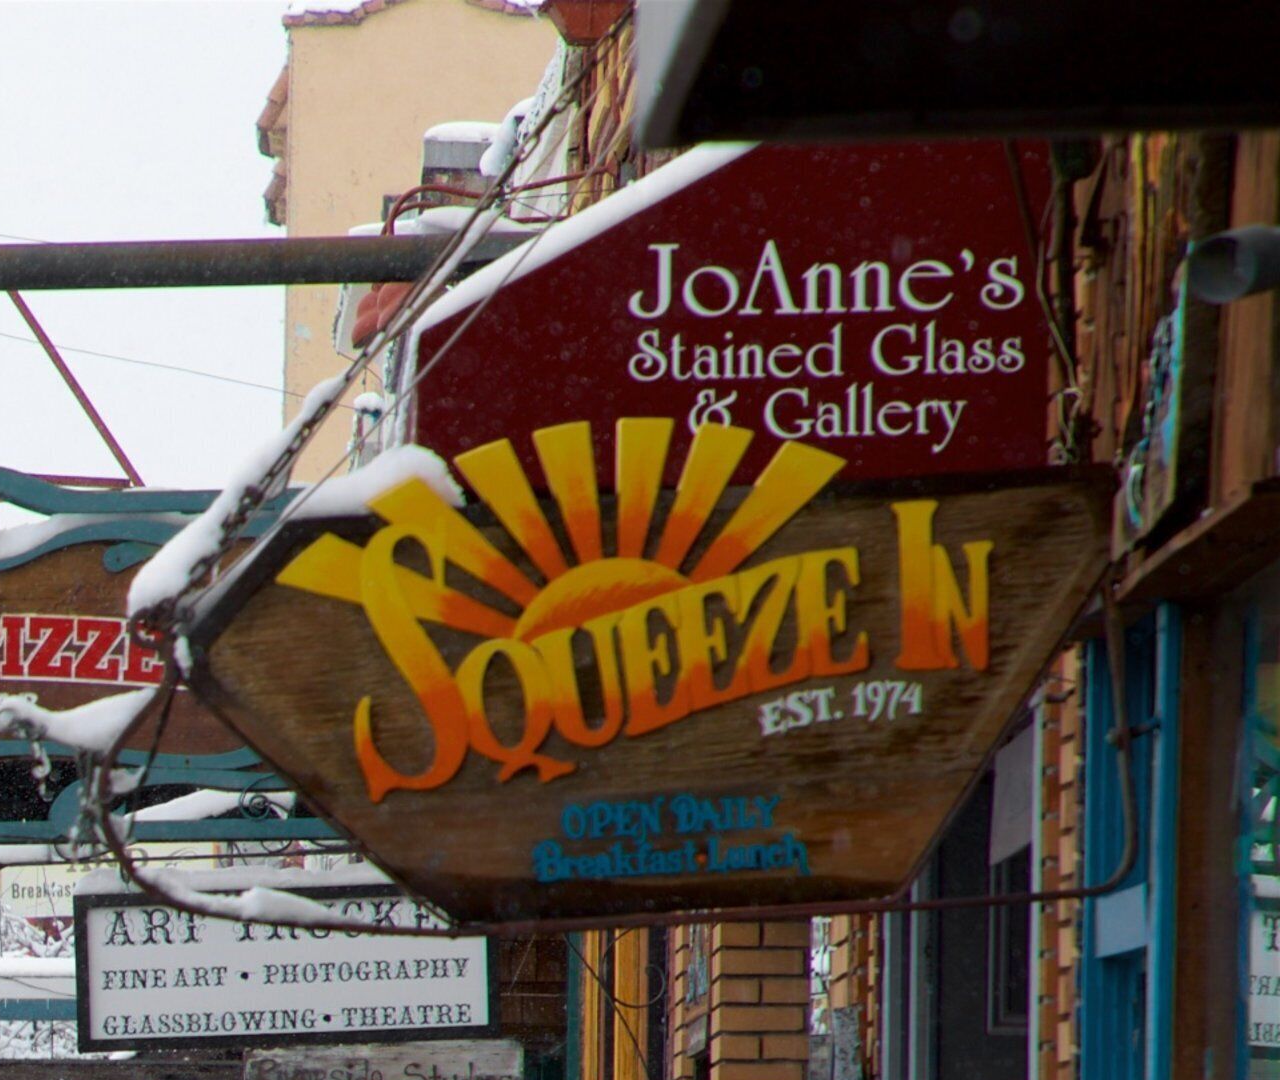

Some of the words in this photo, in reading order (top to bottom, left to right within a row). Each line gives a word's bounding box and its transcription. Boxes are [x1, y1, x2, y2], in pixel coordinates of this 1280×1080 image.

[627, 239, 1025, 318] JoAnne's
[627, 329, 844, 383] Stained
[873, 321, 1025, 375] Glass
[688, 389, 733, 436] &
[763, 387, 966, 453] Gallery
[759, 688, 843, 735] EST.
[851, 682, 923, 721] 1974
[561, 797, 665, 841] OPEN
[534, 838, 697, 883] Breakfast
[705, 832, 810, 876] Lunch
[104, 908, 205, 947] ART
[263, 957, 470, 985] PHOTOGRAPHY
[102, 1008, 318, 1037] GLASSBLOWING
[341, 1003, 473, 1029] THEATRE
